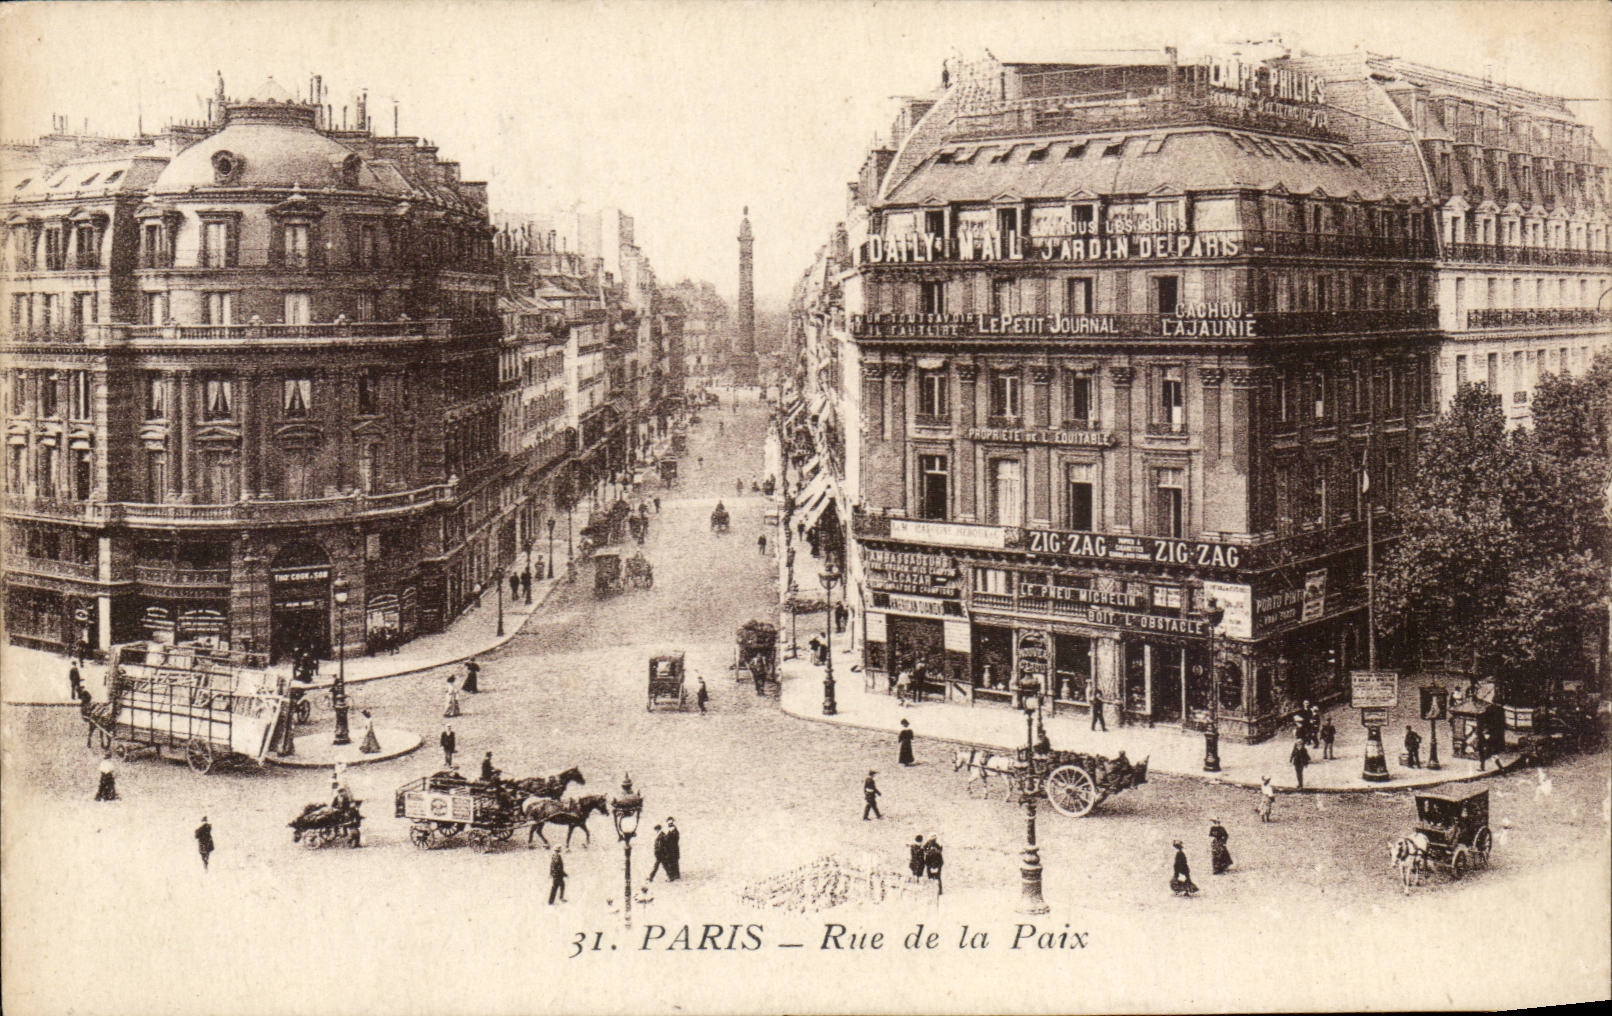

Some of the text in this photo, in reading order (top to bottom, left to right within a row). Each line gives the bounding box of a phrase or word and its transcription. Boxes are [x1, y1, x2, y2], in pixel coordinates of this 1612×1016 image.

[1269, 67, 1326, 105] PHILIPS
[869, 229, 1024, 264] DAILY MAIL
[1041, 234, 1239, 261] JARDIN DE PARIS
[1175, 302, 1243, 319] CACHOU
[978, 313, 1119, 334] LE PETIT JOURNAL
[1162, 318, 1257, 337] LAJAUNIE
[887, 572, 932, 587] ALCAZAR
[1020, 583, 1136, 606] LE PNEU MICHELIN
[1087, 610, 1115, 624] BOIT
